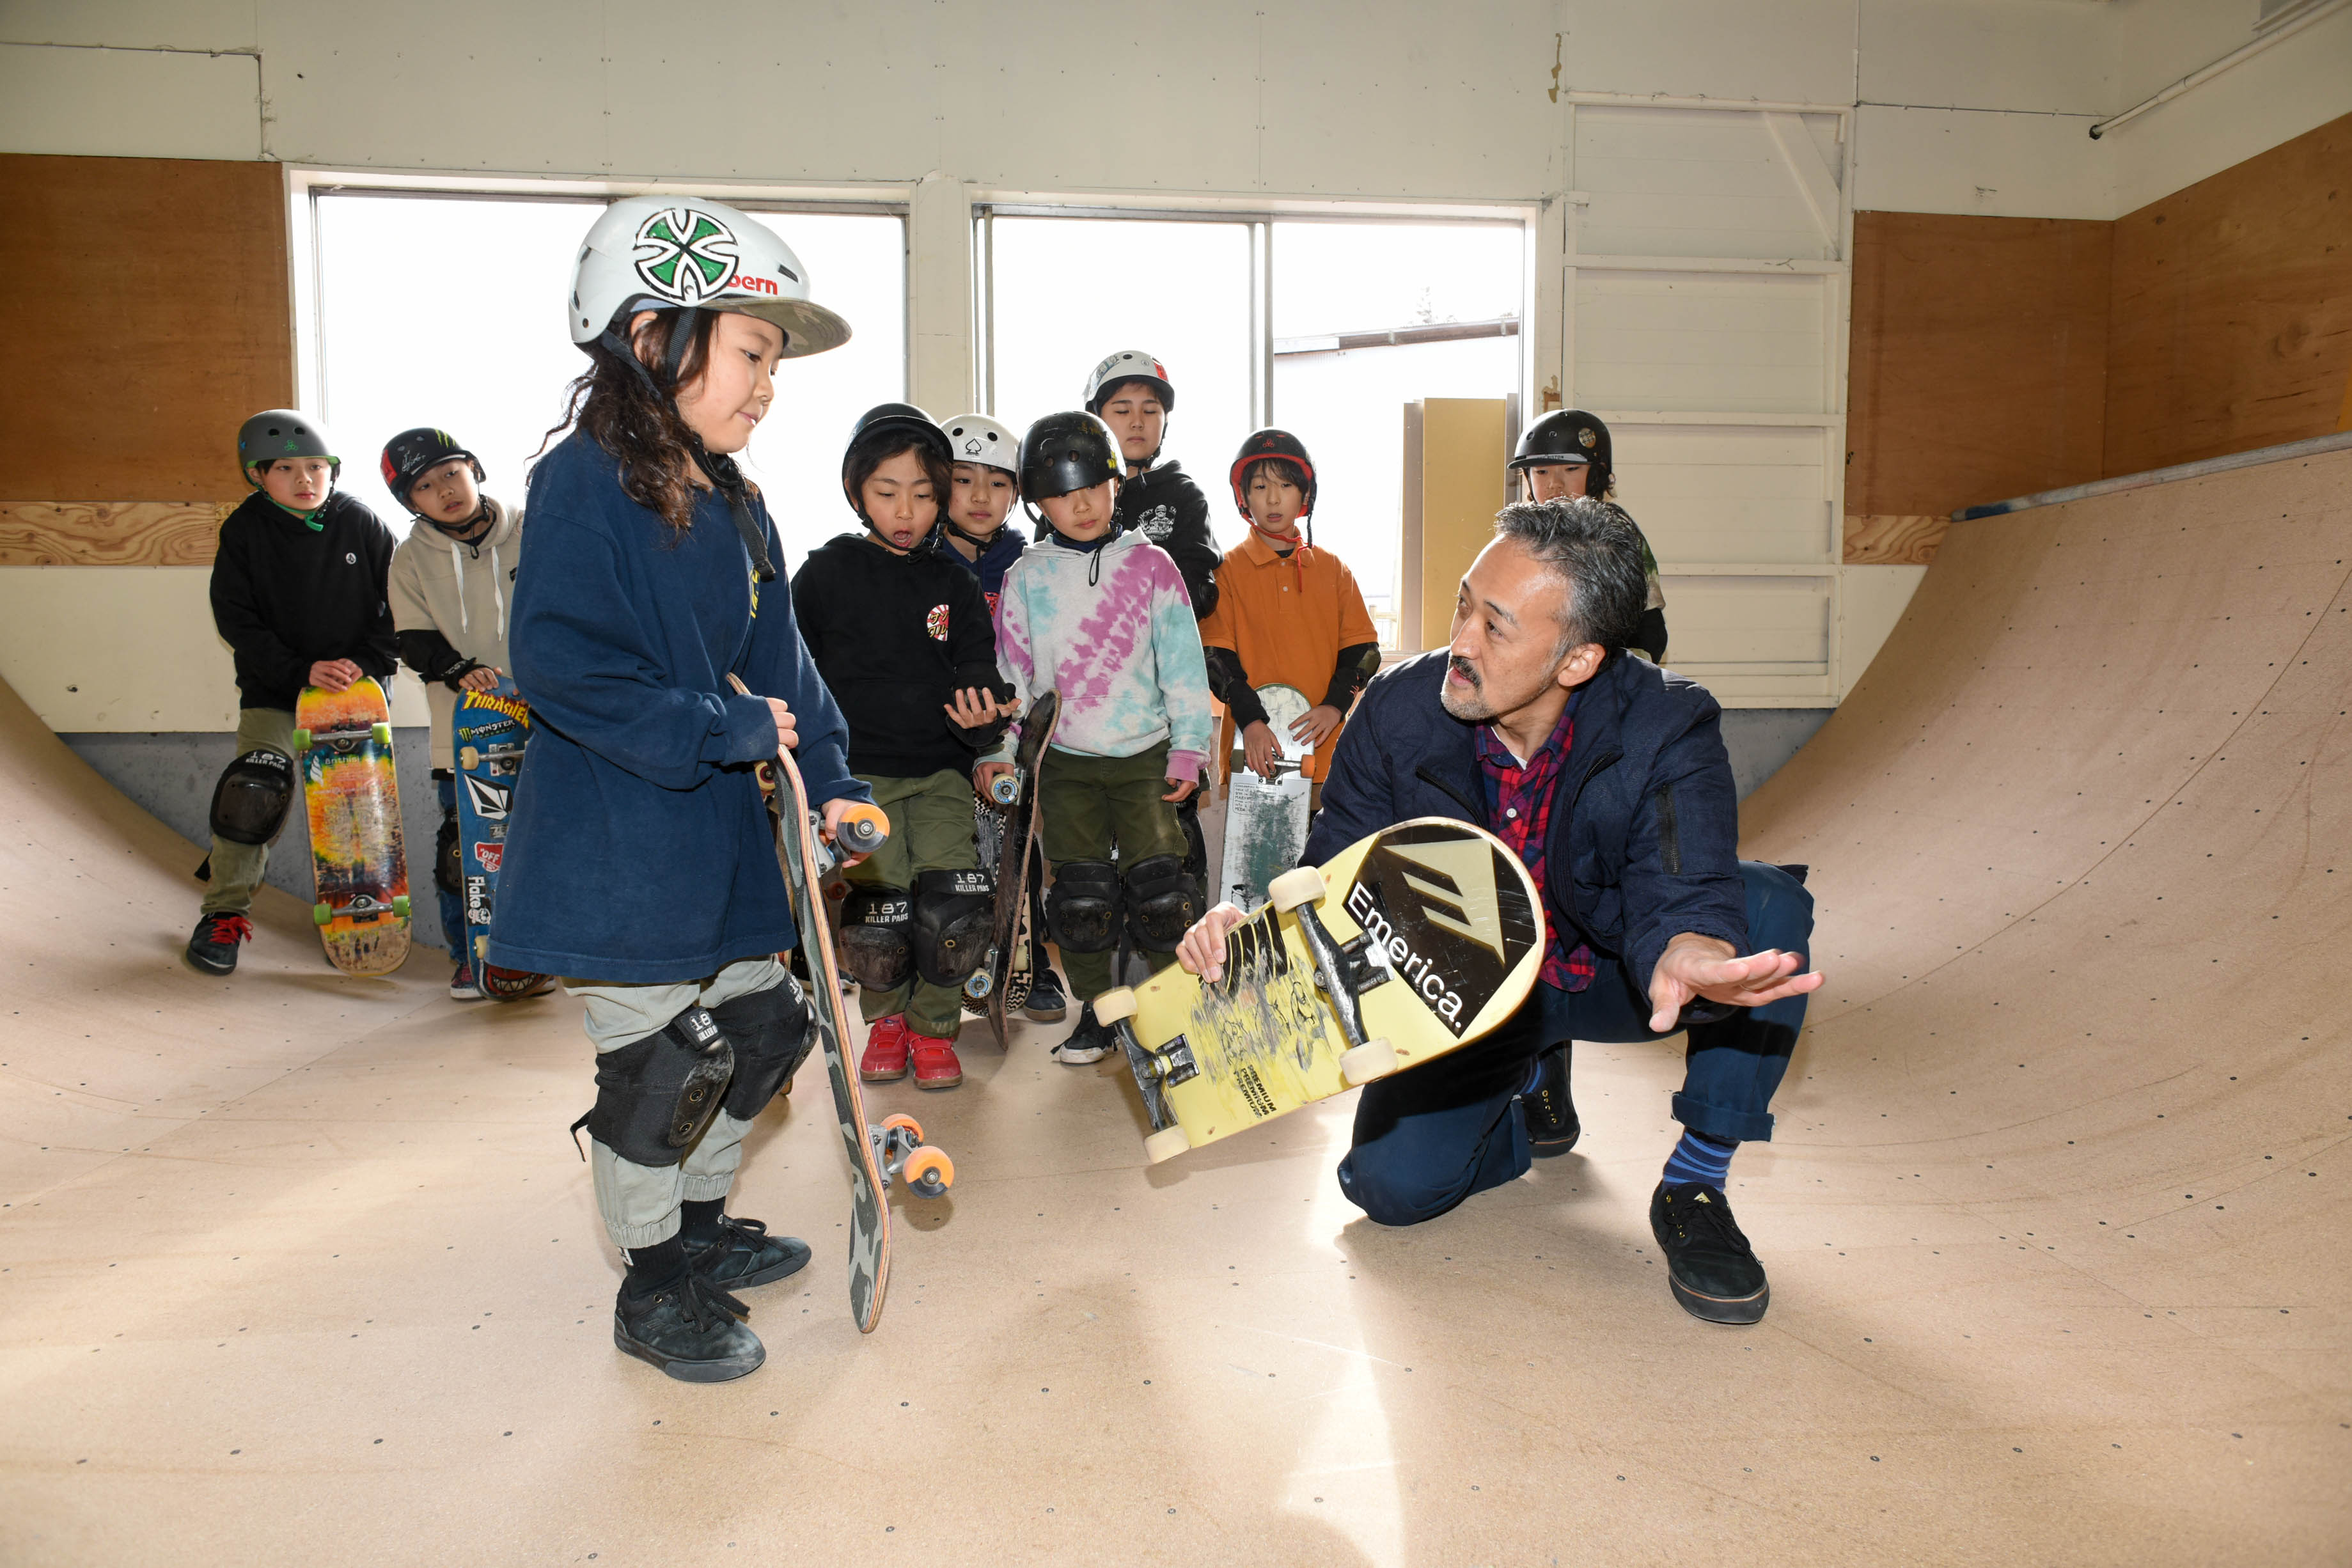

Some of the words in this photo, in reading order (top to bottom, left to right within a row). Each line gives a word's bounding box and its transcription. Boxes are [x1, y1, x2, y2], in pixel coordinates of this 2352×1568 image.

[930, 611, 949, 624] サン
[471, 719, 515, 735] MONSTER
[250, 751, 286, 764] 187
[956, 873, 985, 884] 187
[468, 876, 486, 908] Flake
[869, 902, 907, 914] 187
[891, 913, 909, 923] PADS
[691, 1013, 711, 1030] 18
[1241, 1068, 1270, 1115] PREMIUM
[1247, 1064, 1277, 1112] PREMIUM
